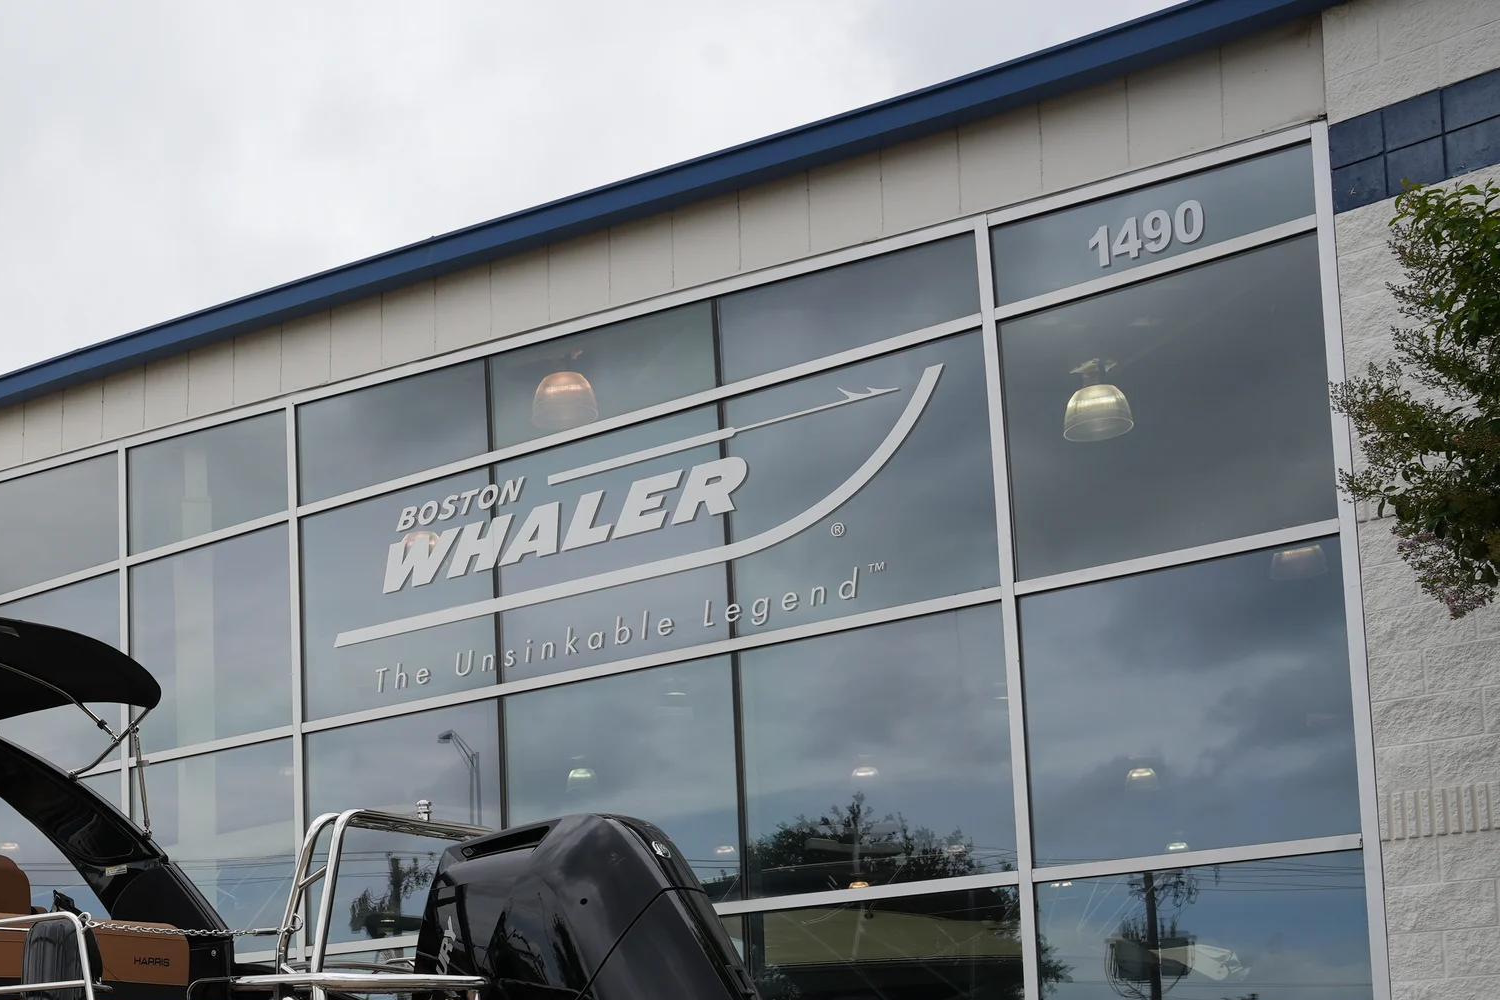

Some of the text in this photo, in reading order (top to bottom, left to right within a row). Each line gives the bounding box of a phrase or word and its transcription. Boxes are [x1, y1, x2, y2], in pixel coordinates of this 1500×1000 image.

[1088, 199, 1204, 267] 1490
[382, 456, 748, 594] WHALER
[395, 475, 525, 532] BOSTON
[375, 662, 431, 693] The
[454, 610, 675, 677] Unsinkable
[133, 956, 170, 967] HARRIS
